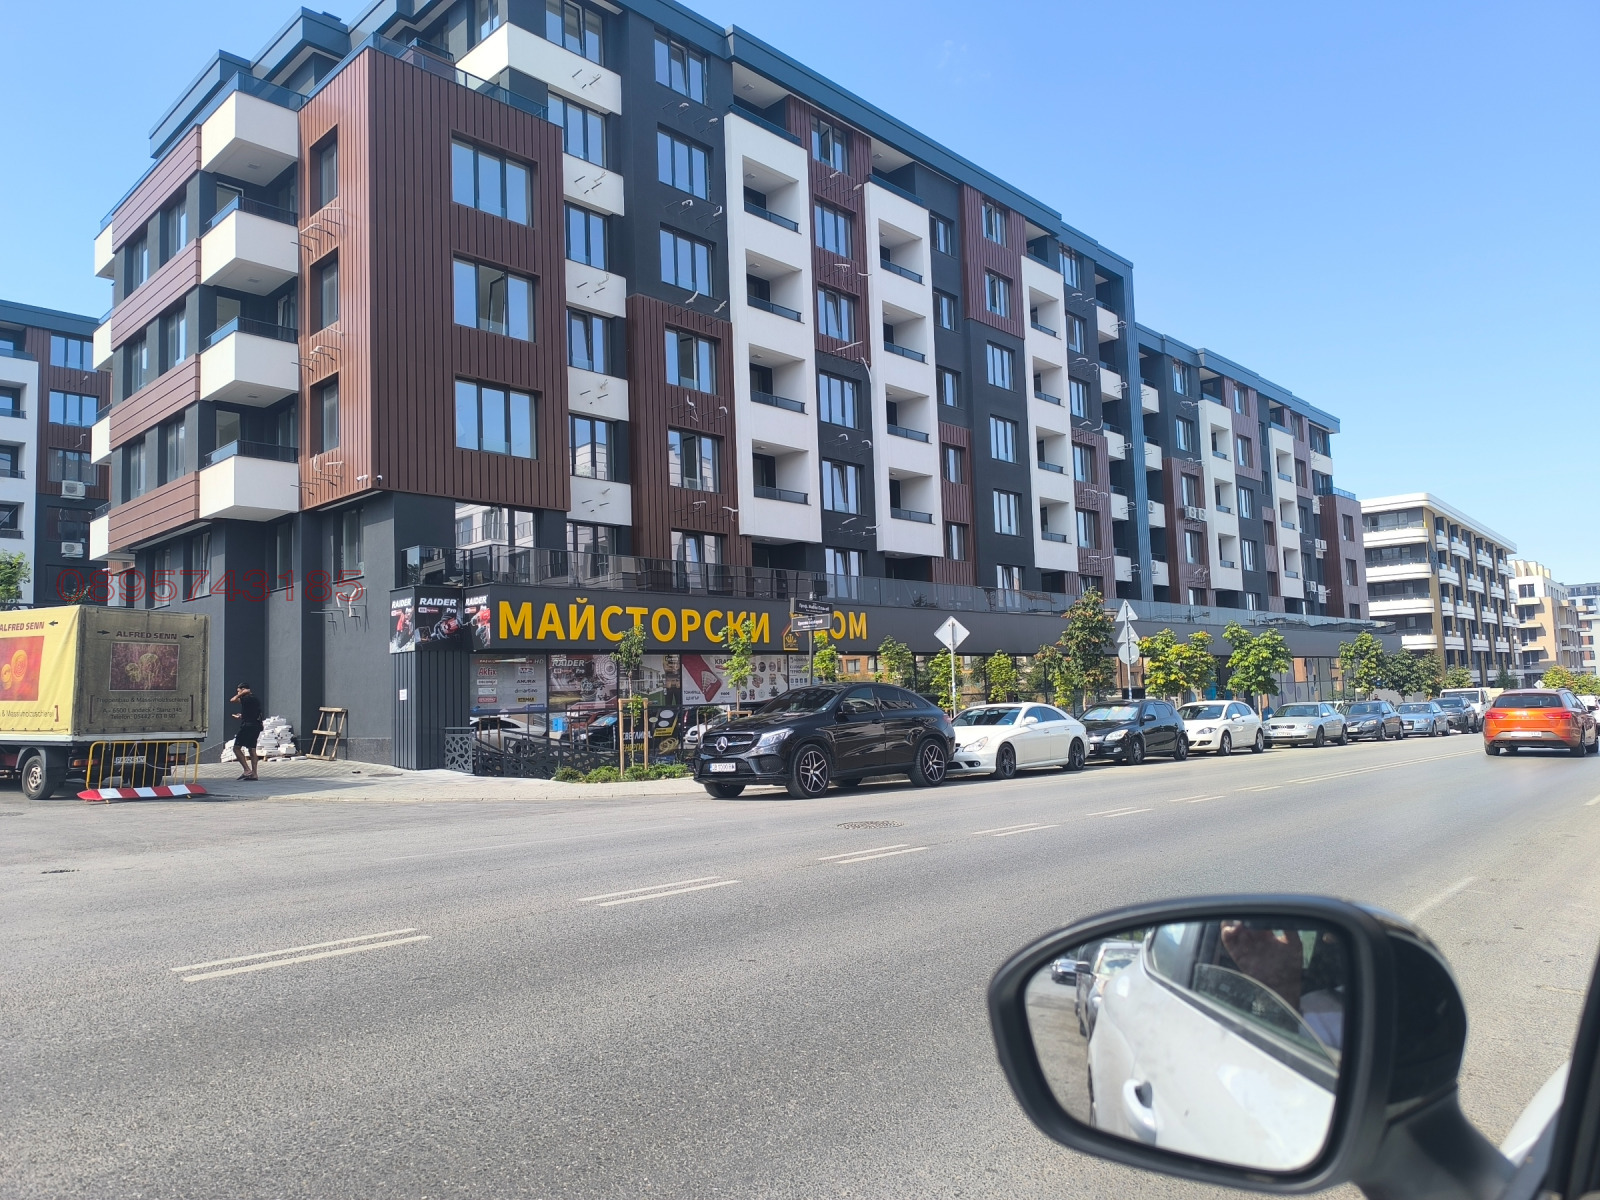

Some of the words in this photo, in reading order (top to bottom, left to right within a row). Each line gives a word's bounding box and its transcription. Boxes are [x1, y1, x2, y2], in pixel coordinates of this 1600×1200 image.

[391, 599, 412, 610] RAIDER
[419, 597, 457, 606] RAIDER
[465, 596, 488, 606] RAIDER
[498, 597, 770, 644] МАЙСТОРСКИ
[0, 623, 25, 632] ALFRED
[25, 621, 45, 630] SENN
[116, 630, 152, 639] ALFRED
[153, 632, 178, 640] SENN
[479, 668, 497, 676] Akfix
